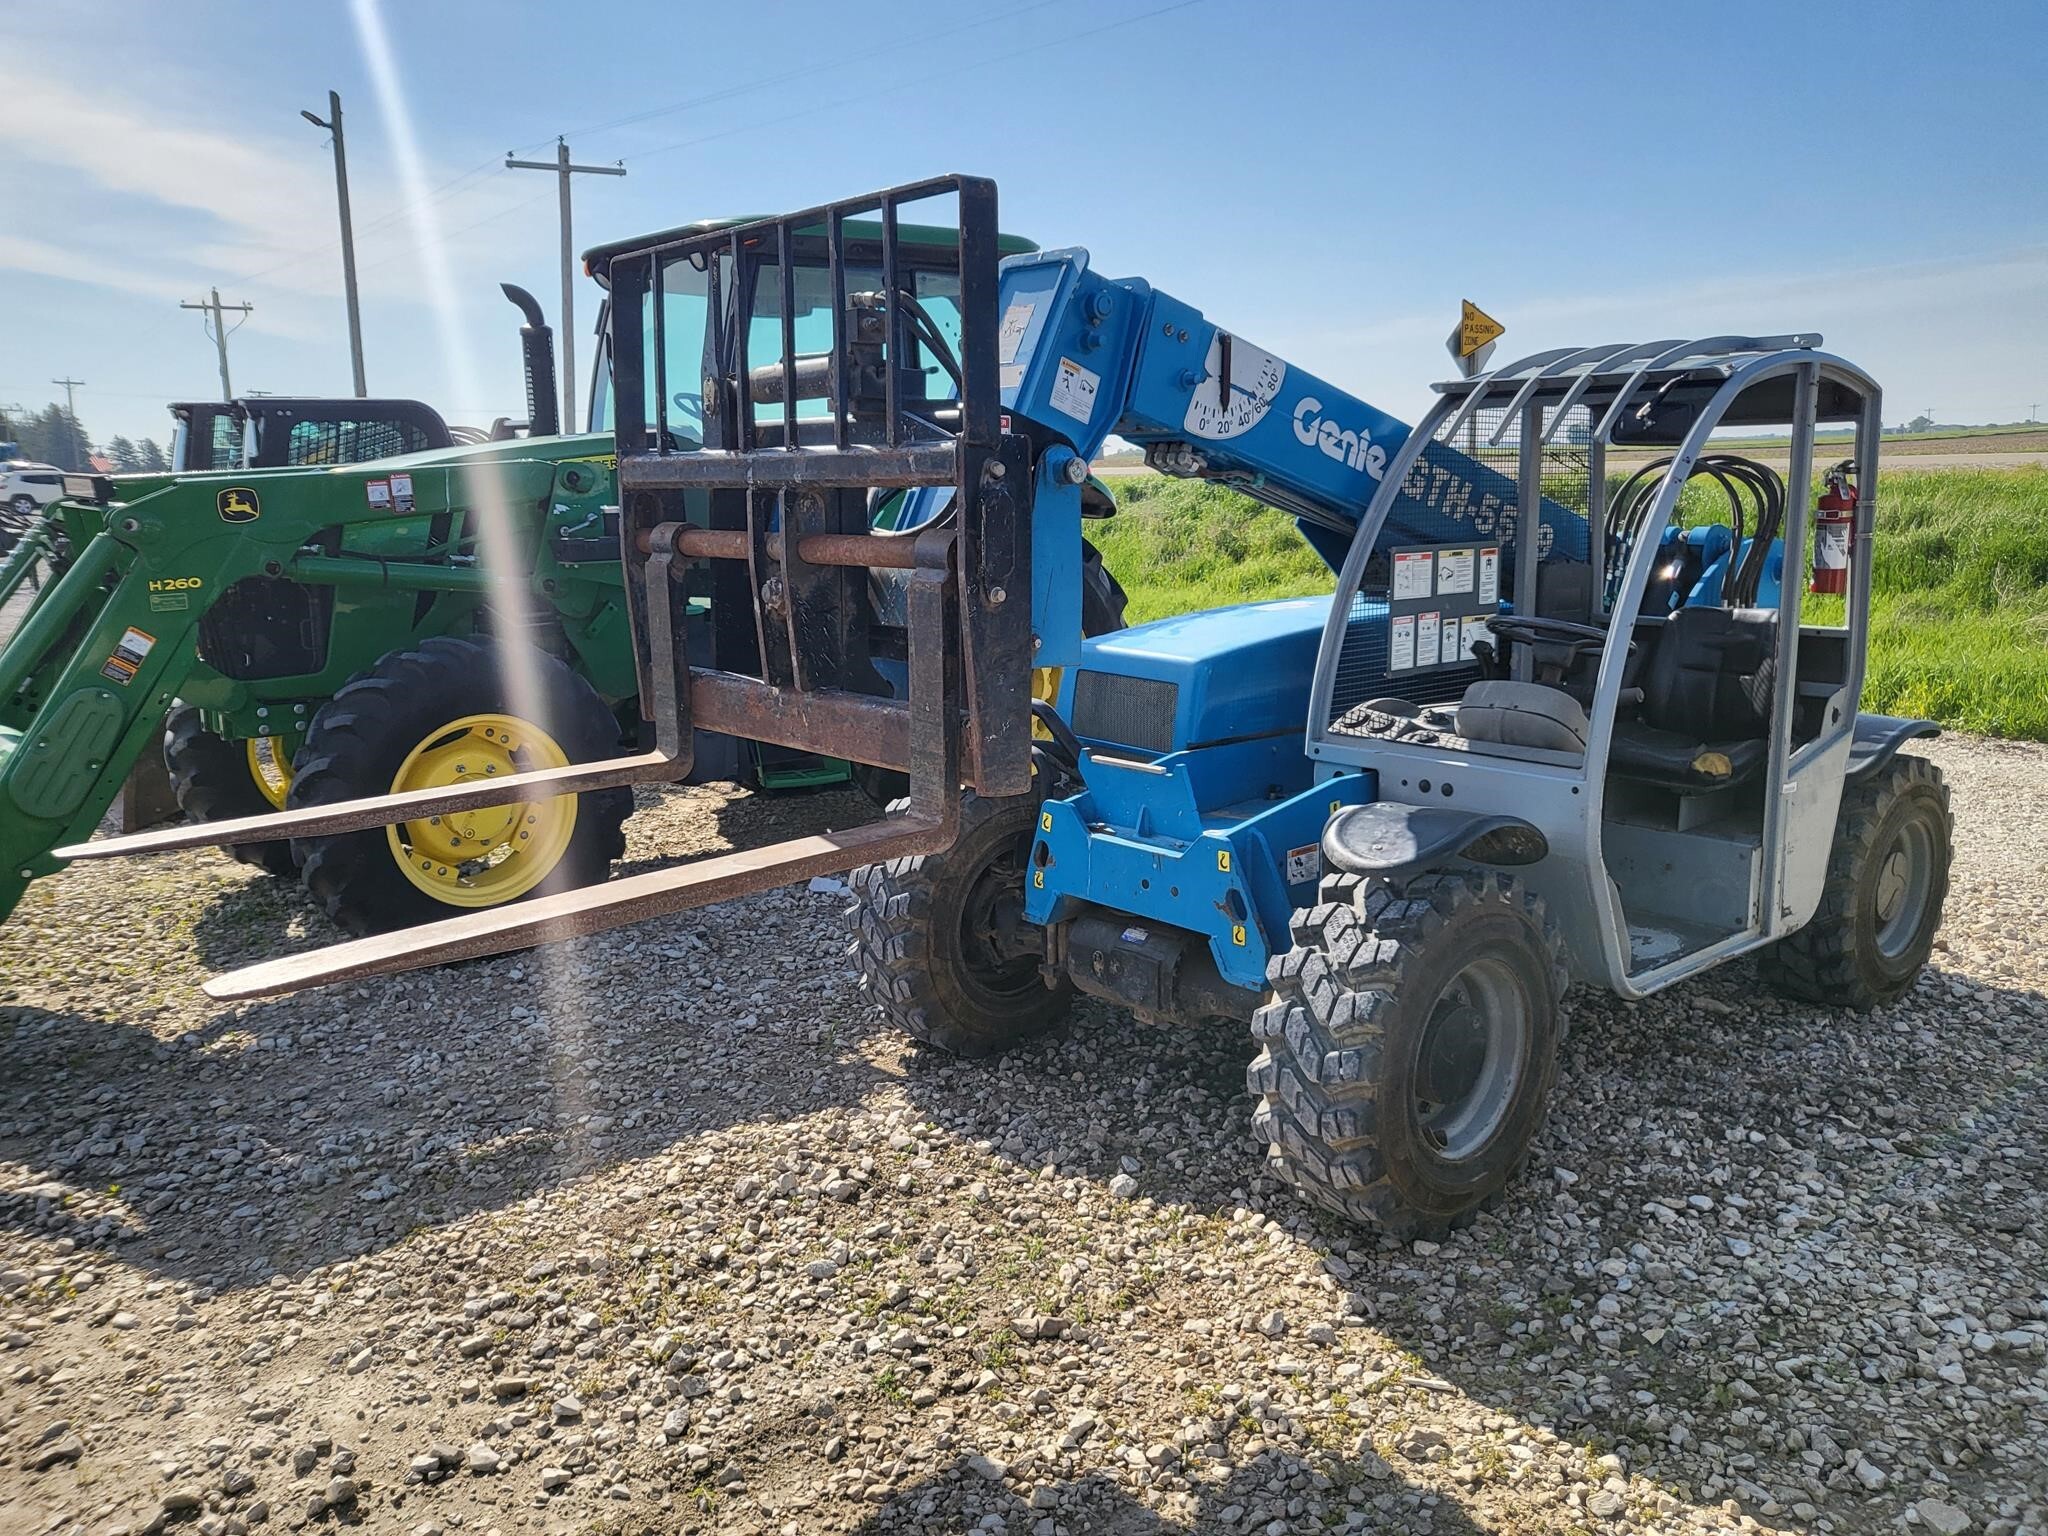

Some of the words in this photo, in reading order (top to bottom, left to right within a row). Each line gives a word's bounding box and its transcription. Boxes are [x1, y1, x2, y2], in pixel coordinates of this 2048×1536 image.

[1464, 312, 1475, 321] NO
[1464, 324, 1494, 334] PASSING
[1464, 336, 1478, 345] ZONE
[1293, 397, 1387, 481] Genie
